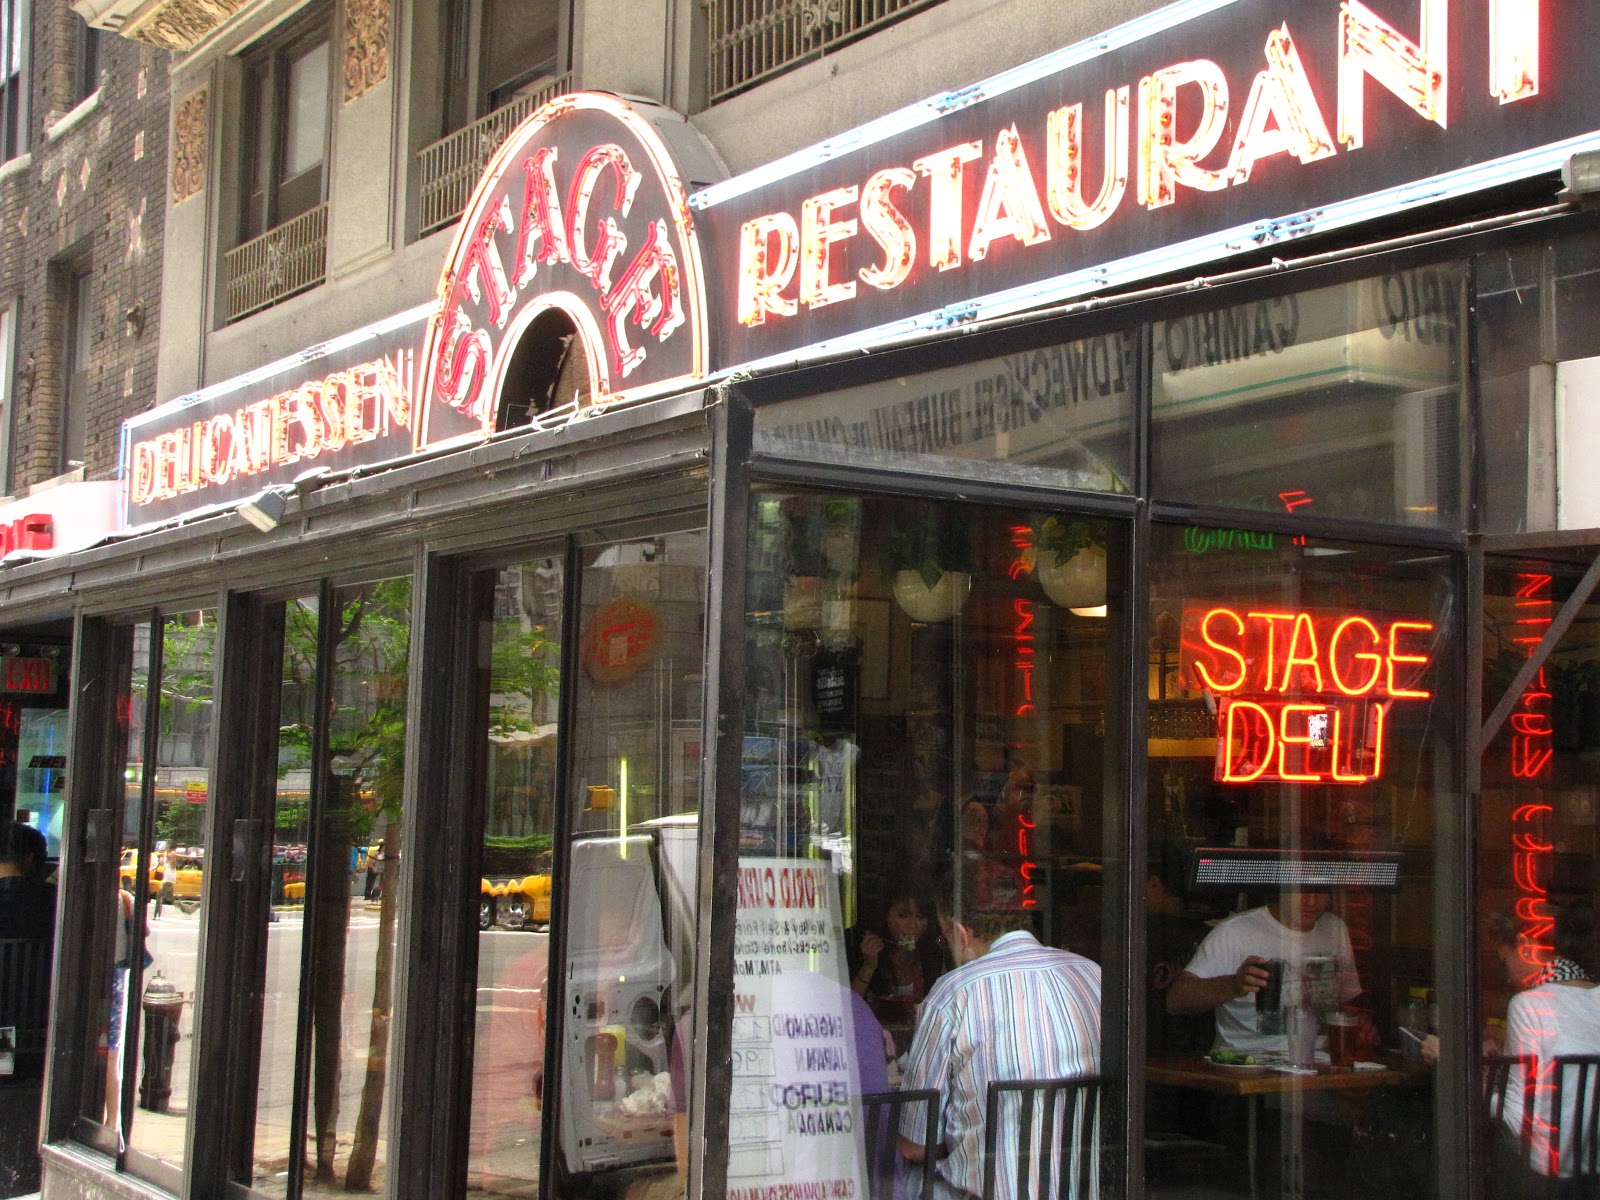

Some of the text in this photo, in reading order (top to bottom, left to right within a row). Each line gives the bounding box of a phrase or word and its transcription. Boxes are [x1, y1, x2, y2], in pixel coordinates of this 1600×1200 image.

[434, 143, 685, 421] STAGE
[131, 348, 413, 506] DELICATESSEN
[6, 658, 50, 690] EXIT
[1194, 607, 1434, 698] STAGE
[1222, 701, 1384, 784] DELI
